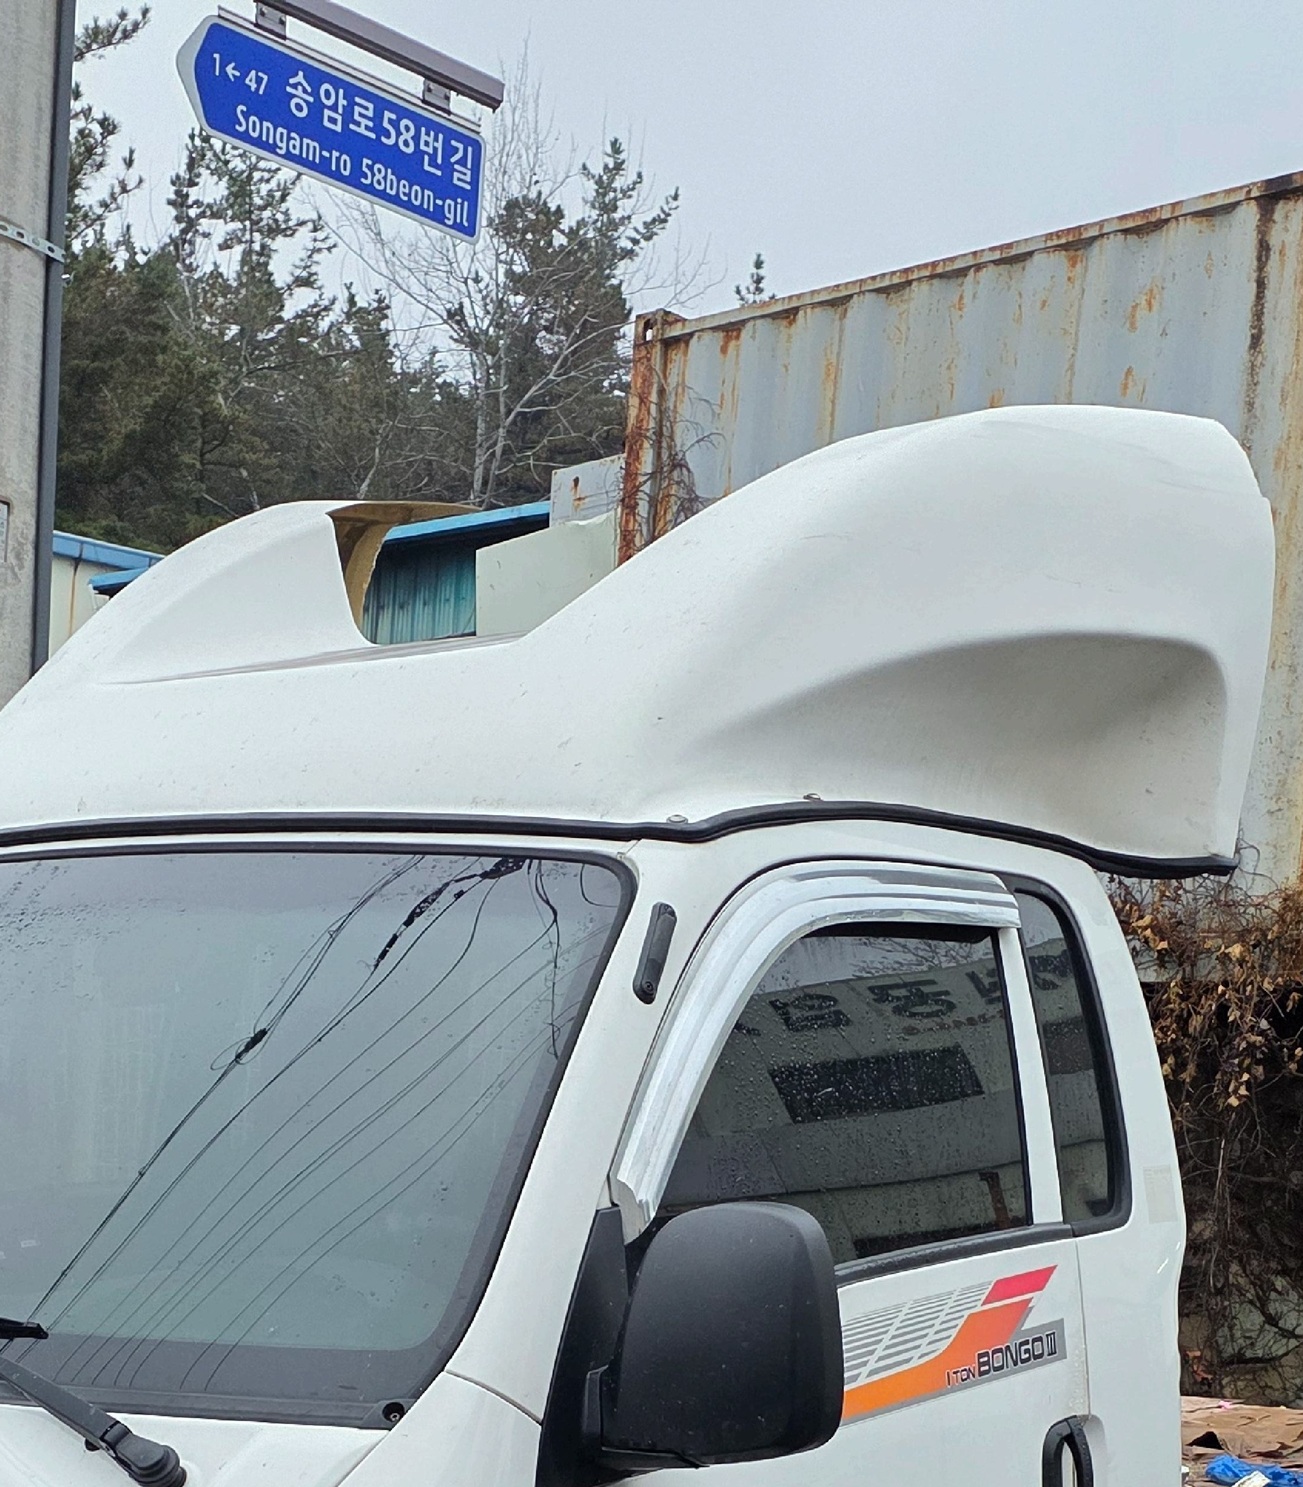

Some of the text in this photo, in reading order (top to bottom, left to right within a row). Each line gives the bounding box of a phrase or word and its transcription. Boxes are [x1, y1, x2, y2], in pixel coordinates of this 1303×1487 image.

[235, 104, 469, 228] Songam-ro 58beon-gil
[285, 69, 473, 190] 송암로58번길
[977, 1335, 1044, 1377] BONGO
